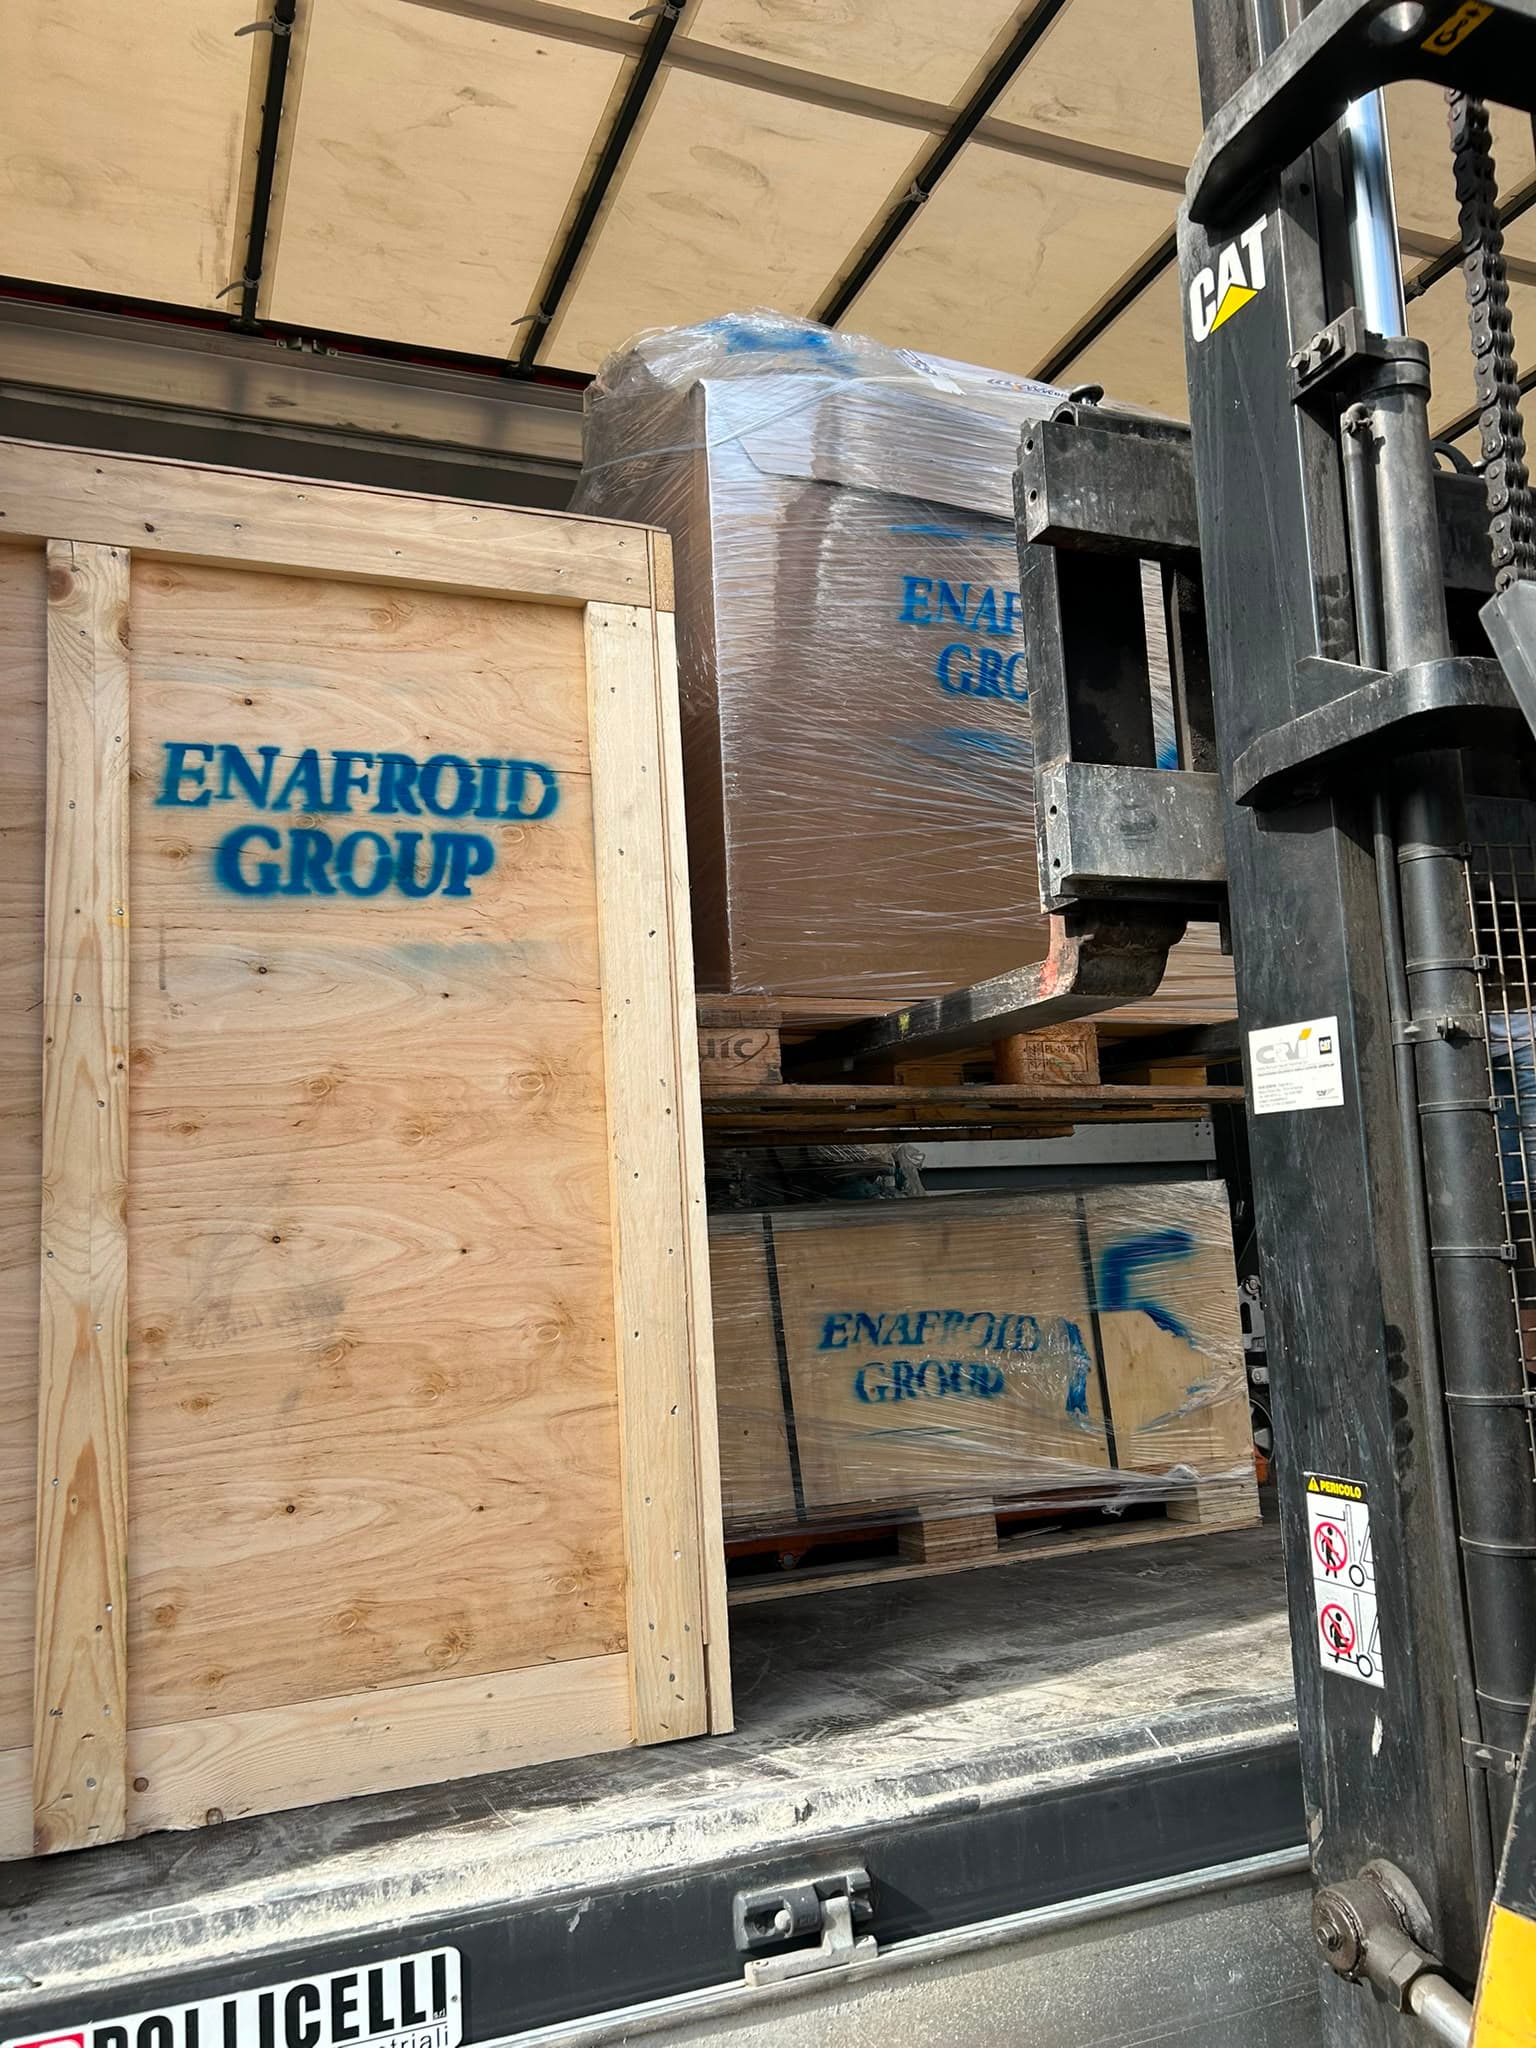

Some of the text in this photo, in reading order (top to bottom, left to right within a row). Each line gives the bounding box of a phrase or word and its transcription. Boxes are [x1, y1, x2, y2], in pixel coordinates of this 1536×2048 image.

[1189, 213, 1268, 343] CAT
[155, 741, 562, 822] ENAFROID
[216, 823, 496, 898] GROUP
[1320, 1480, 1362, 1499] PERICOLO
